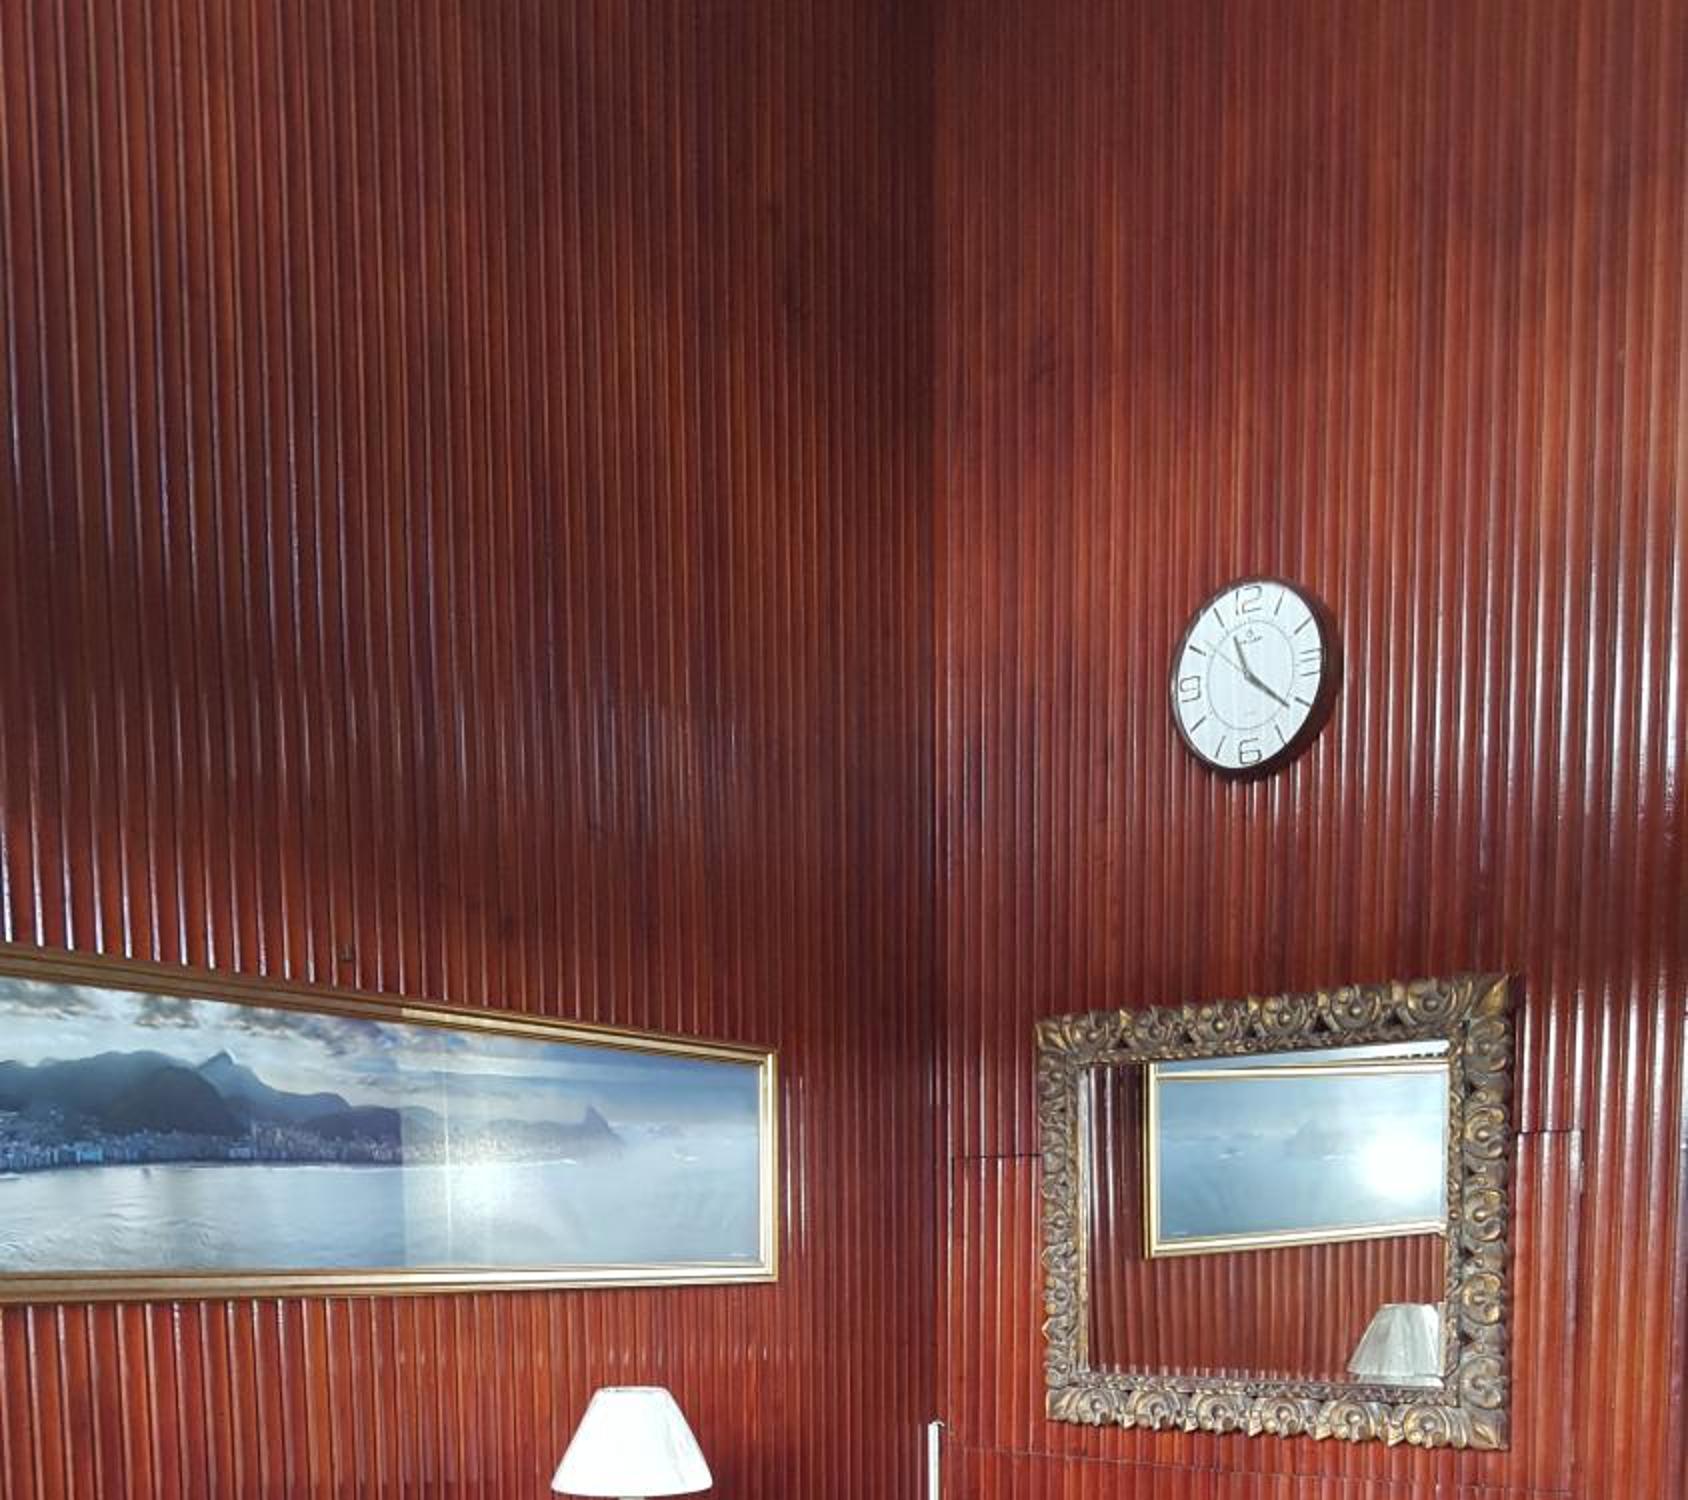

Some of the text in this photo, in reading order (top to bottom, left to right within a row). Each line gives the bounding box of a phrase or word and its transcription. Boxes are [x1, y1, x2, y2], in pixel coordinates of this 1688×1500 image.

[1235, 585, 1263, 616] 12
[1179, 674, 1202, 704] 9
[1238, 737, 1263, 765] 6
